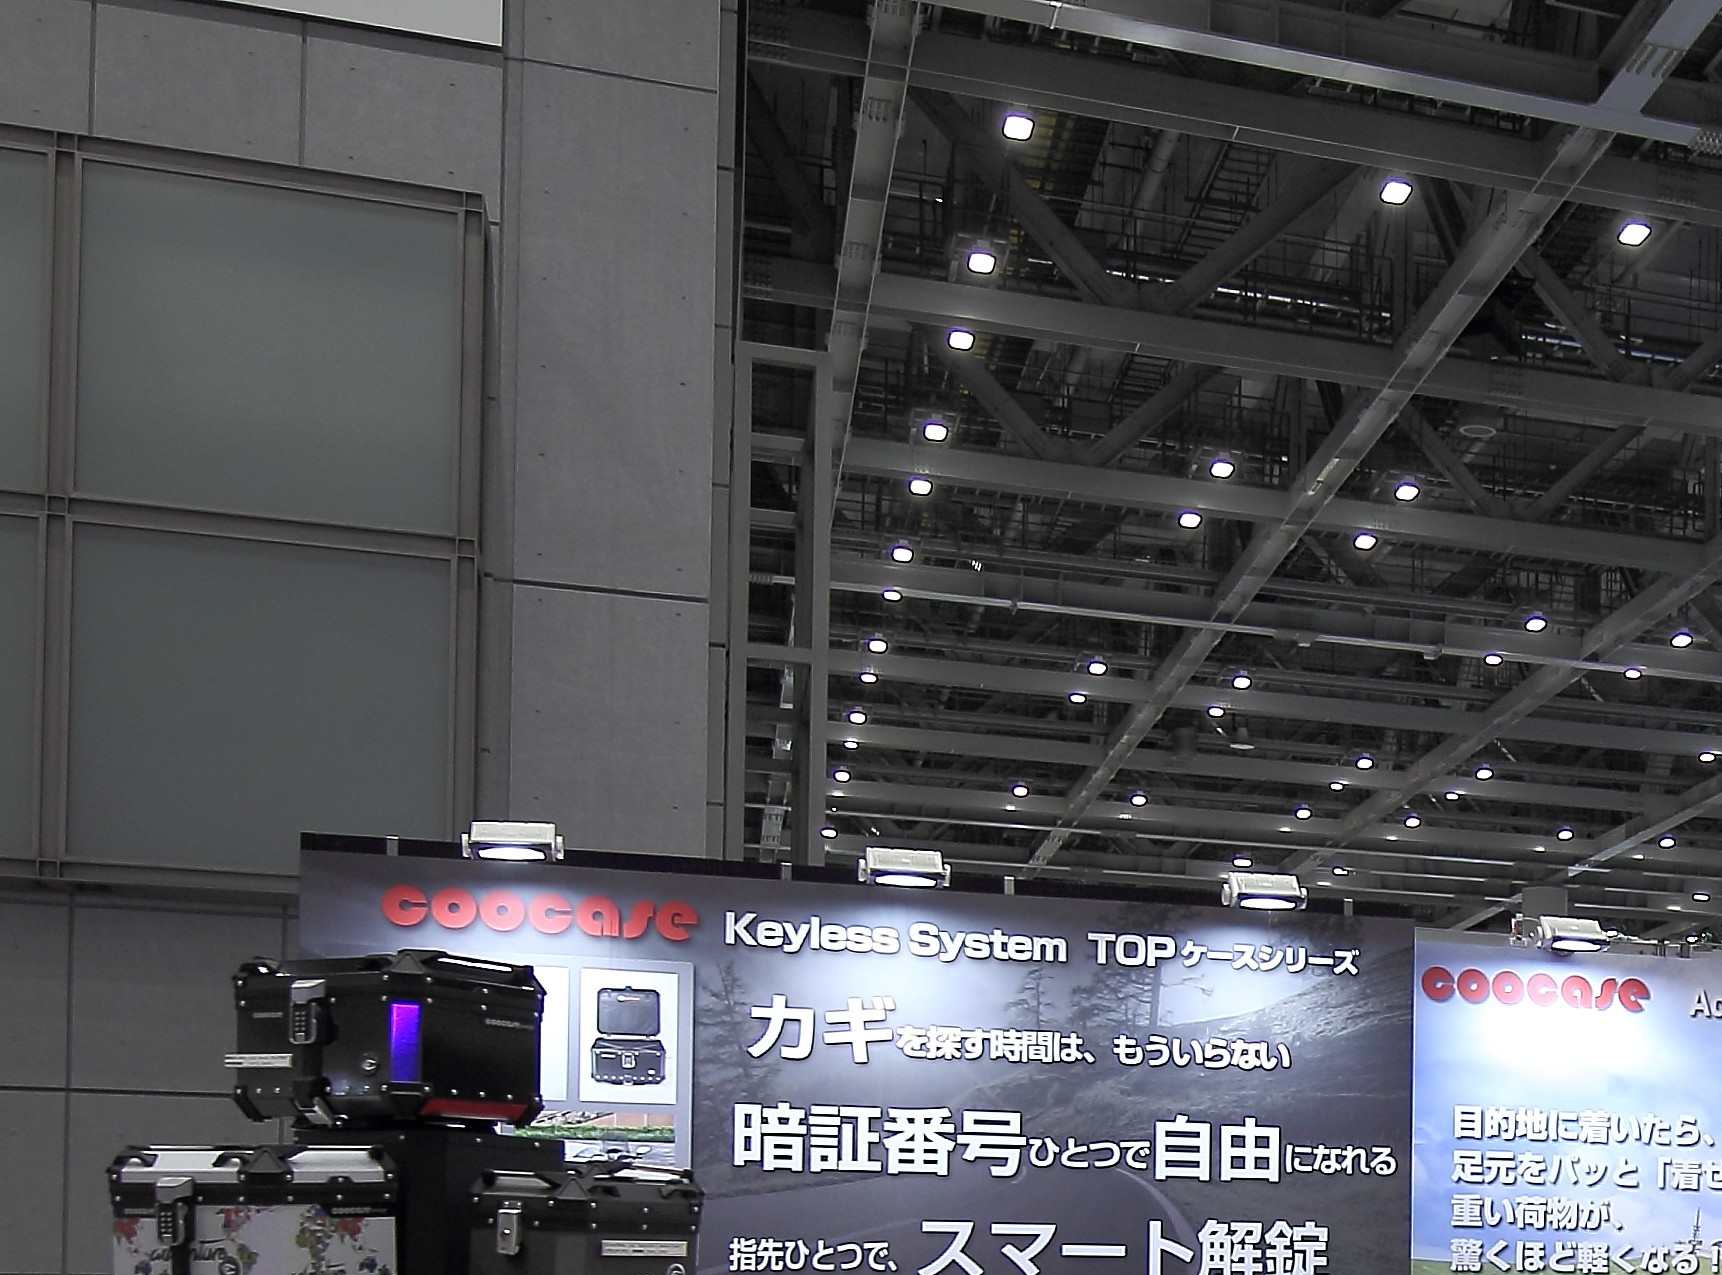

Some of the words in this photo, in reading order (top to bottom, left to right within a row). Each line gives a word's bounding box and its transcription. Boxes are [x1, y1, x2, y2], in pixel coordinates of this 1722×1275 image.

[724, 911, 900, 954] Keyless
[908, 921, 1068, 963] System
[1087, 932, 1360, 976] TOPケースシリーズ
[733, 1102, 1397, 1182] 暗証番号ひとつで自由になれる
[1452, 1105, 1716, 1147] 目的地に着いたら、
[1451, 1195, 1624, 1232] 重い荷物が、
[1450, 1238, 1722, 1275] 驚くほど軽くなる！
